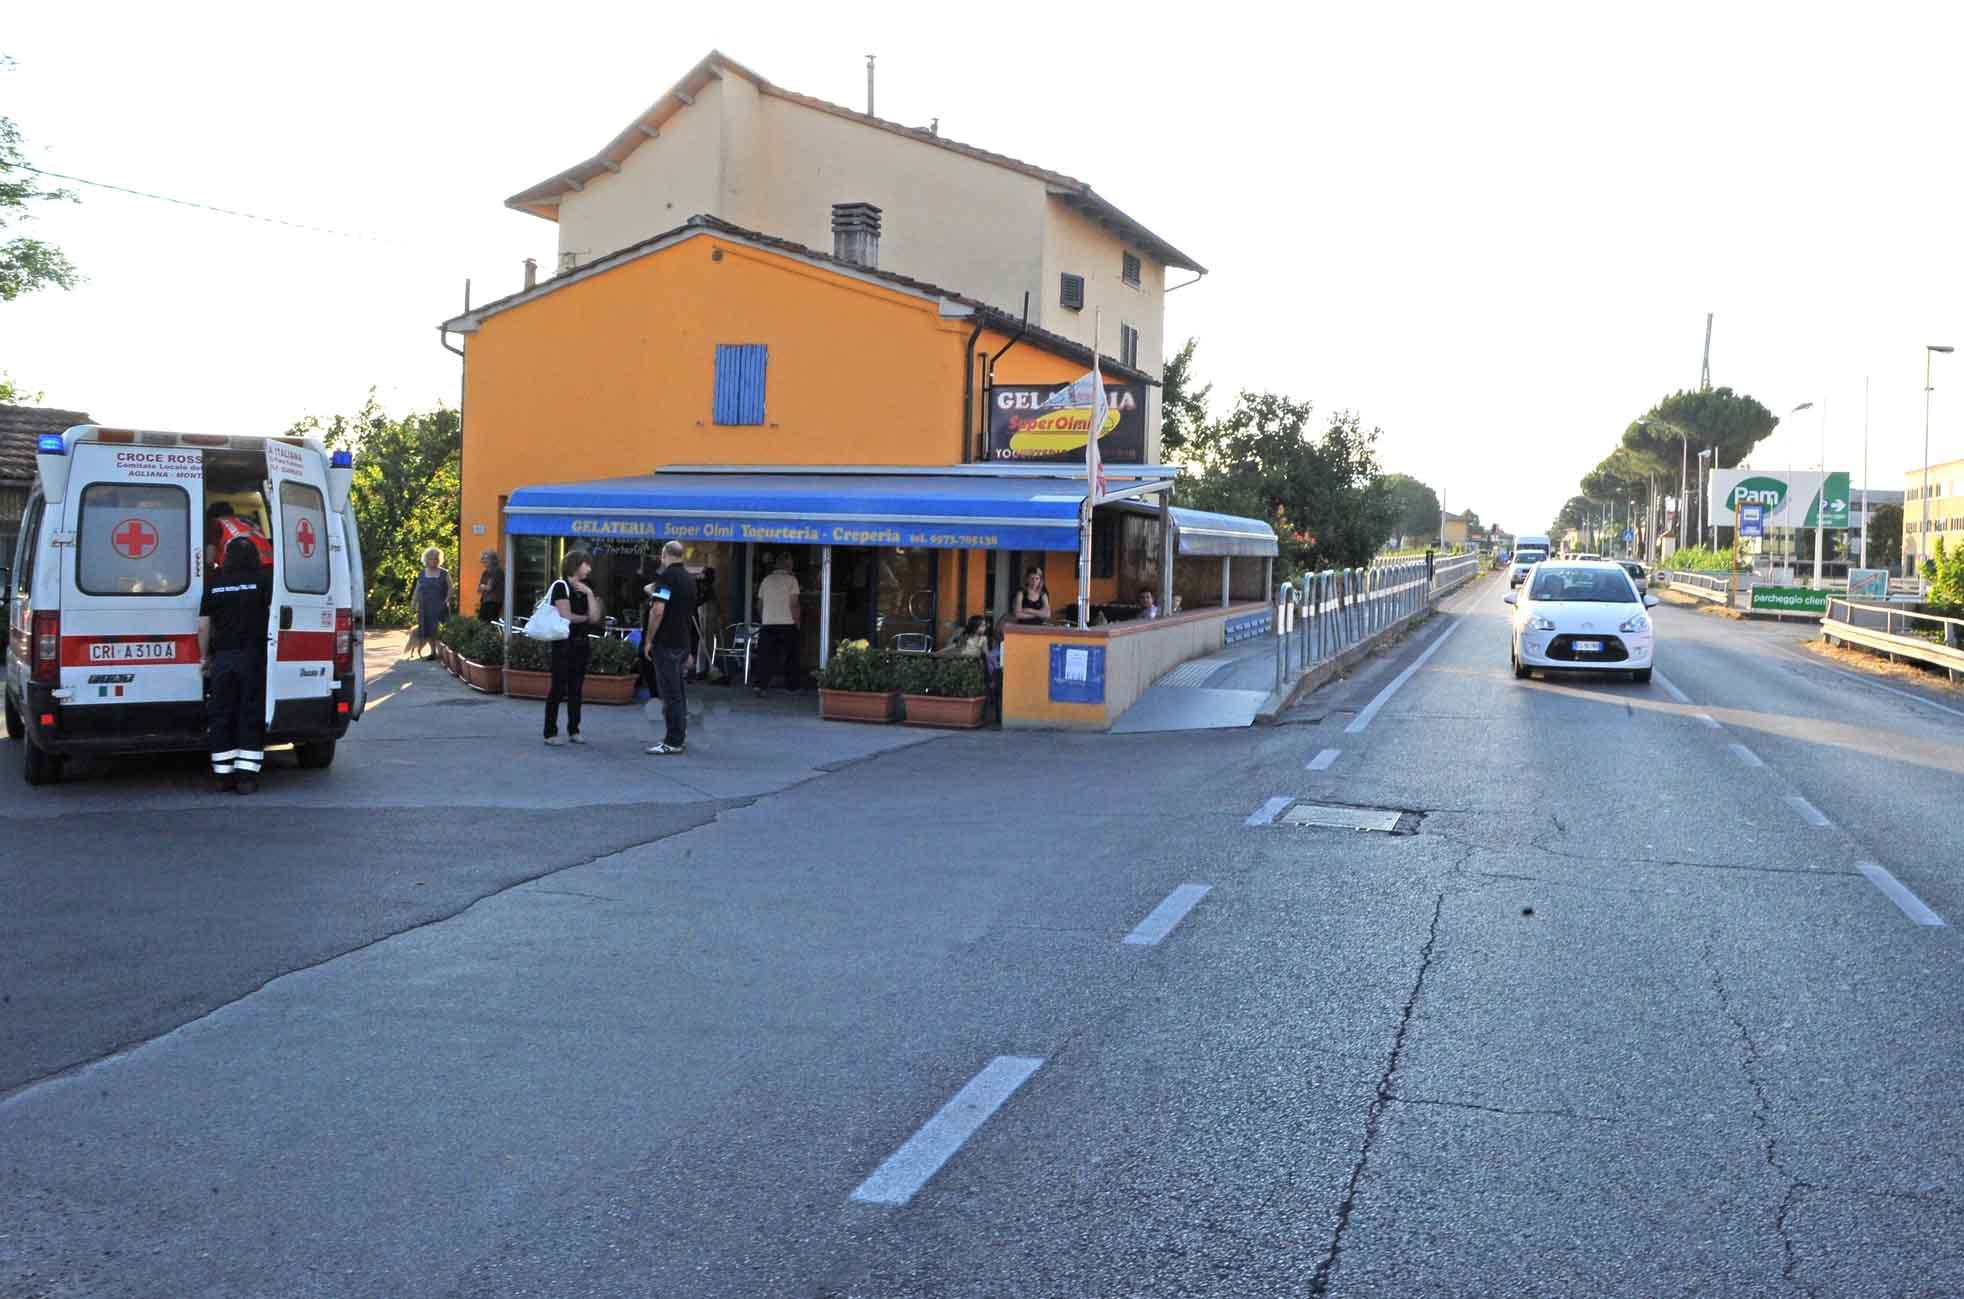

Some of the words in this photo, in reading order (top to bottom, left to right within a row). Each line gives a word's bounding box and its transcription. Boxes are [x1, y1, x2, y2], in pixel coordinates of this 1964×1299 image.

[997, 391, 1136, 411] GELIA
[1008, 416, 1054, 431] Super
[116, 452, 164, 462] CROCE
[1734, 486, 1778, 504] Pam
[572, 520, 655, 534] GELATERIA
[664, 522, 699, 537] Super
[703, 523, 733, 537] Olmi
[741, 524, 818, 539] Yogurteria
[832, 527, 899, 544] Creperia
[1753, 594, 1803, 606] parcheggio
[1804, 597, 1826, 606] clien
[92, 645, 115, 659] CRI
